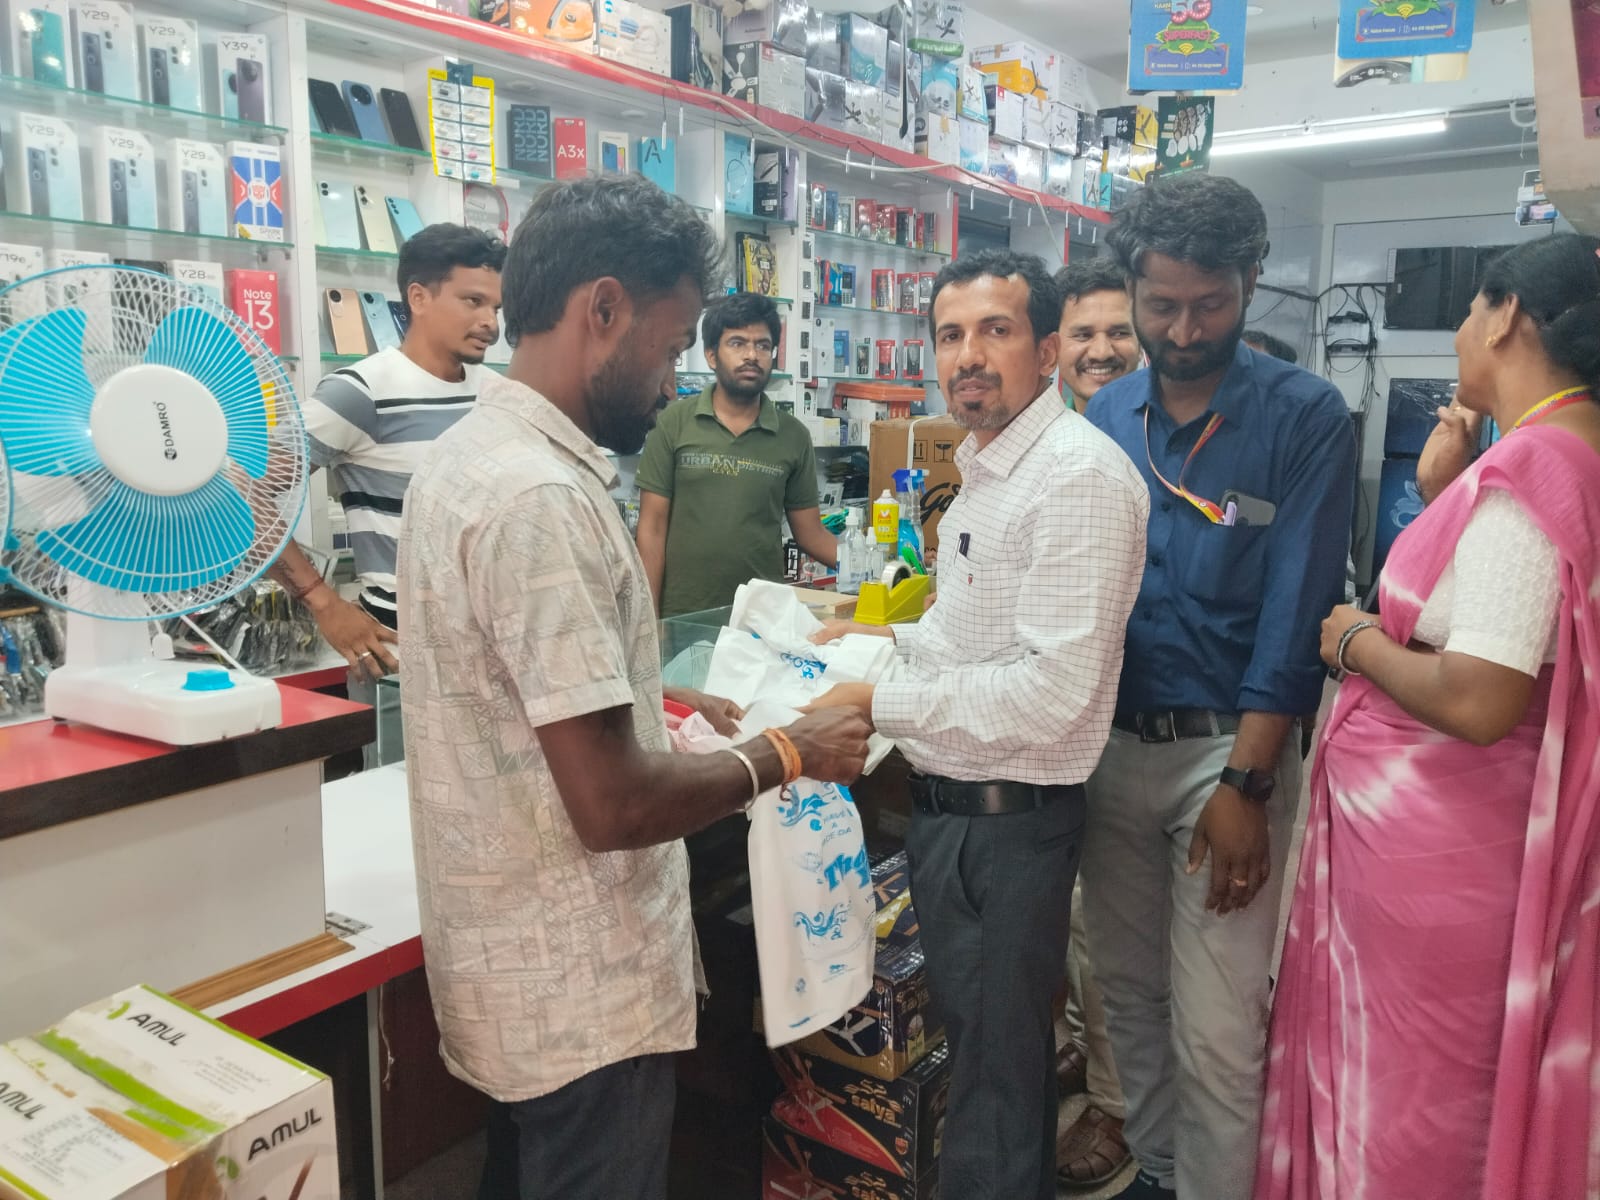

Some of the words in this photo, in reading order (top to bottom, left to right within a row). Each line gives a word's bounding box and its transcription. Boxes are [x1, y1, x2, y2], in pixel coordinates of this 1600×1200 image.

[81, 9, 110, 21] Y29
[148, 25, 176, 36] Y29
[108, 135, 135, 149] Y29
[557, 144, 585, 159] A3x
[178, 269, 206, 280] Y28
[243, 289, 273, 300] Note
[244, 300, 274, 330] 13
[156, 402, 175, 447] DAMRO
[127, 1014, 186, 1046] AMUL
[248, 1107, 322, 1162] AMUL
